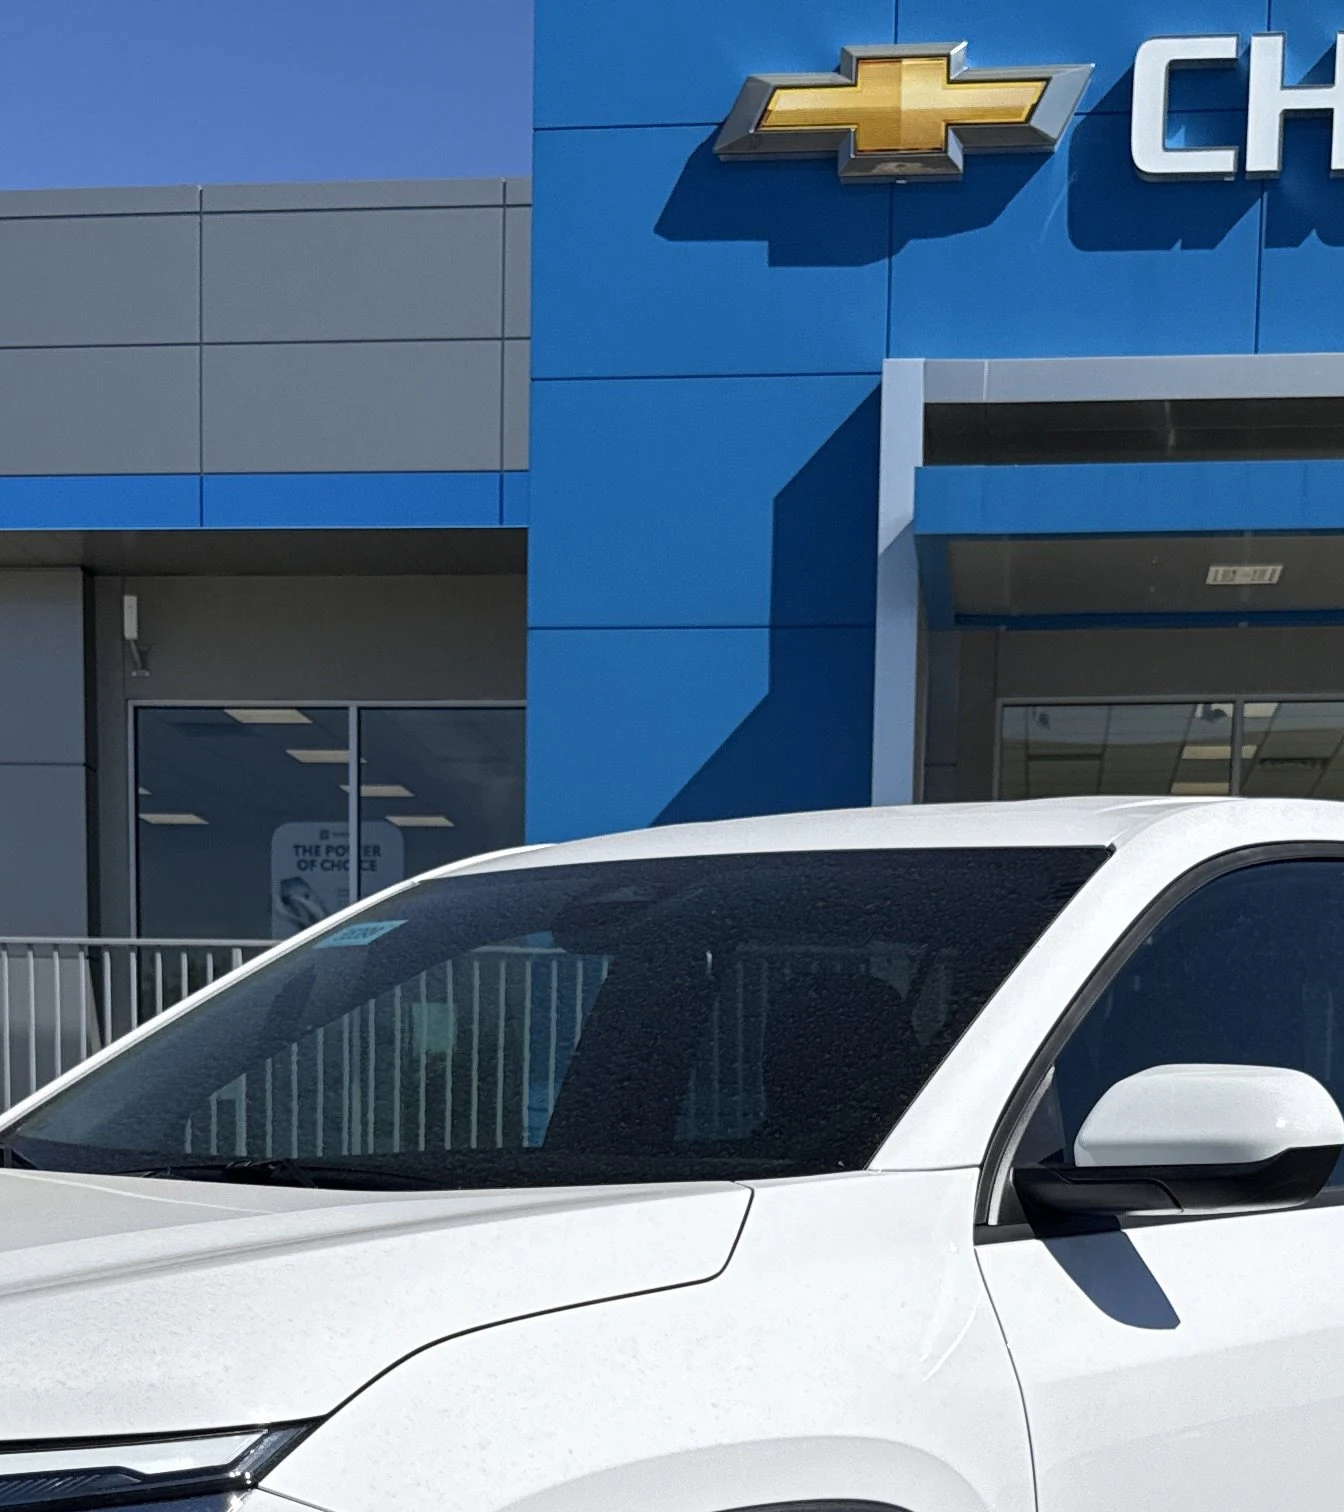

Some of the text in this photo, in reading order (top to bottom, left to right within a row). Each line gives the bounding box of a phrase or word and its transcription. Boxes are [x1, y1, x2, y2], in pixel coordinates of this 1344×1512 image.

[293, 844, 381, 857] THE POER
[297, 859, 377, 872] OF CHOCE
